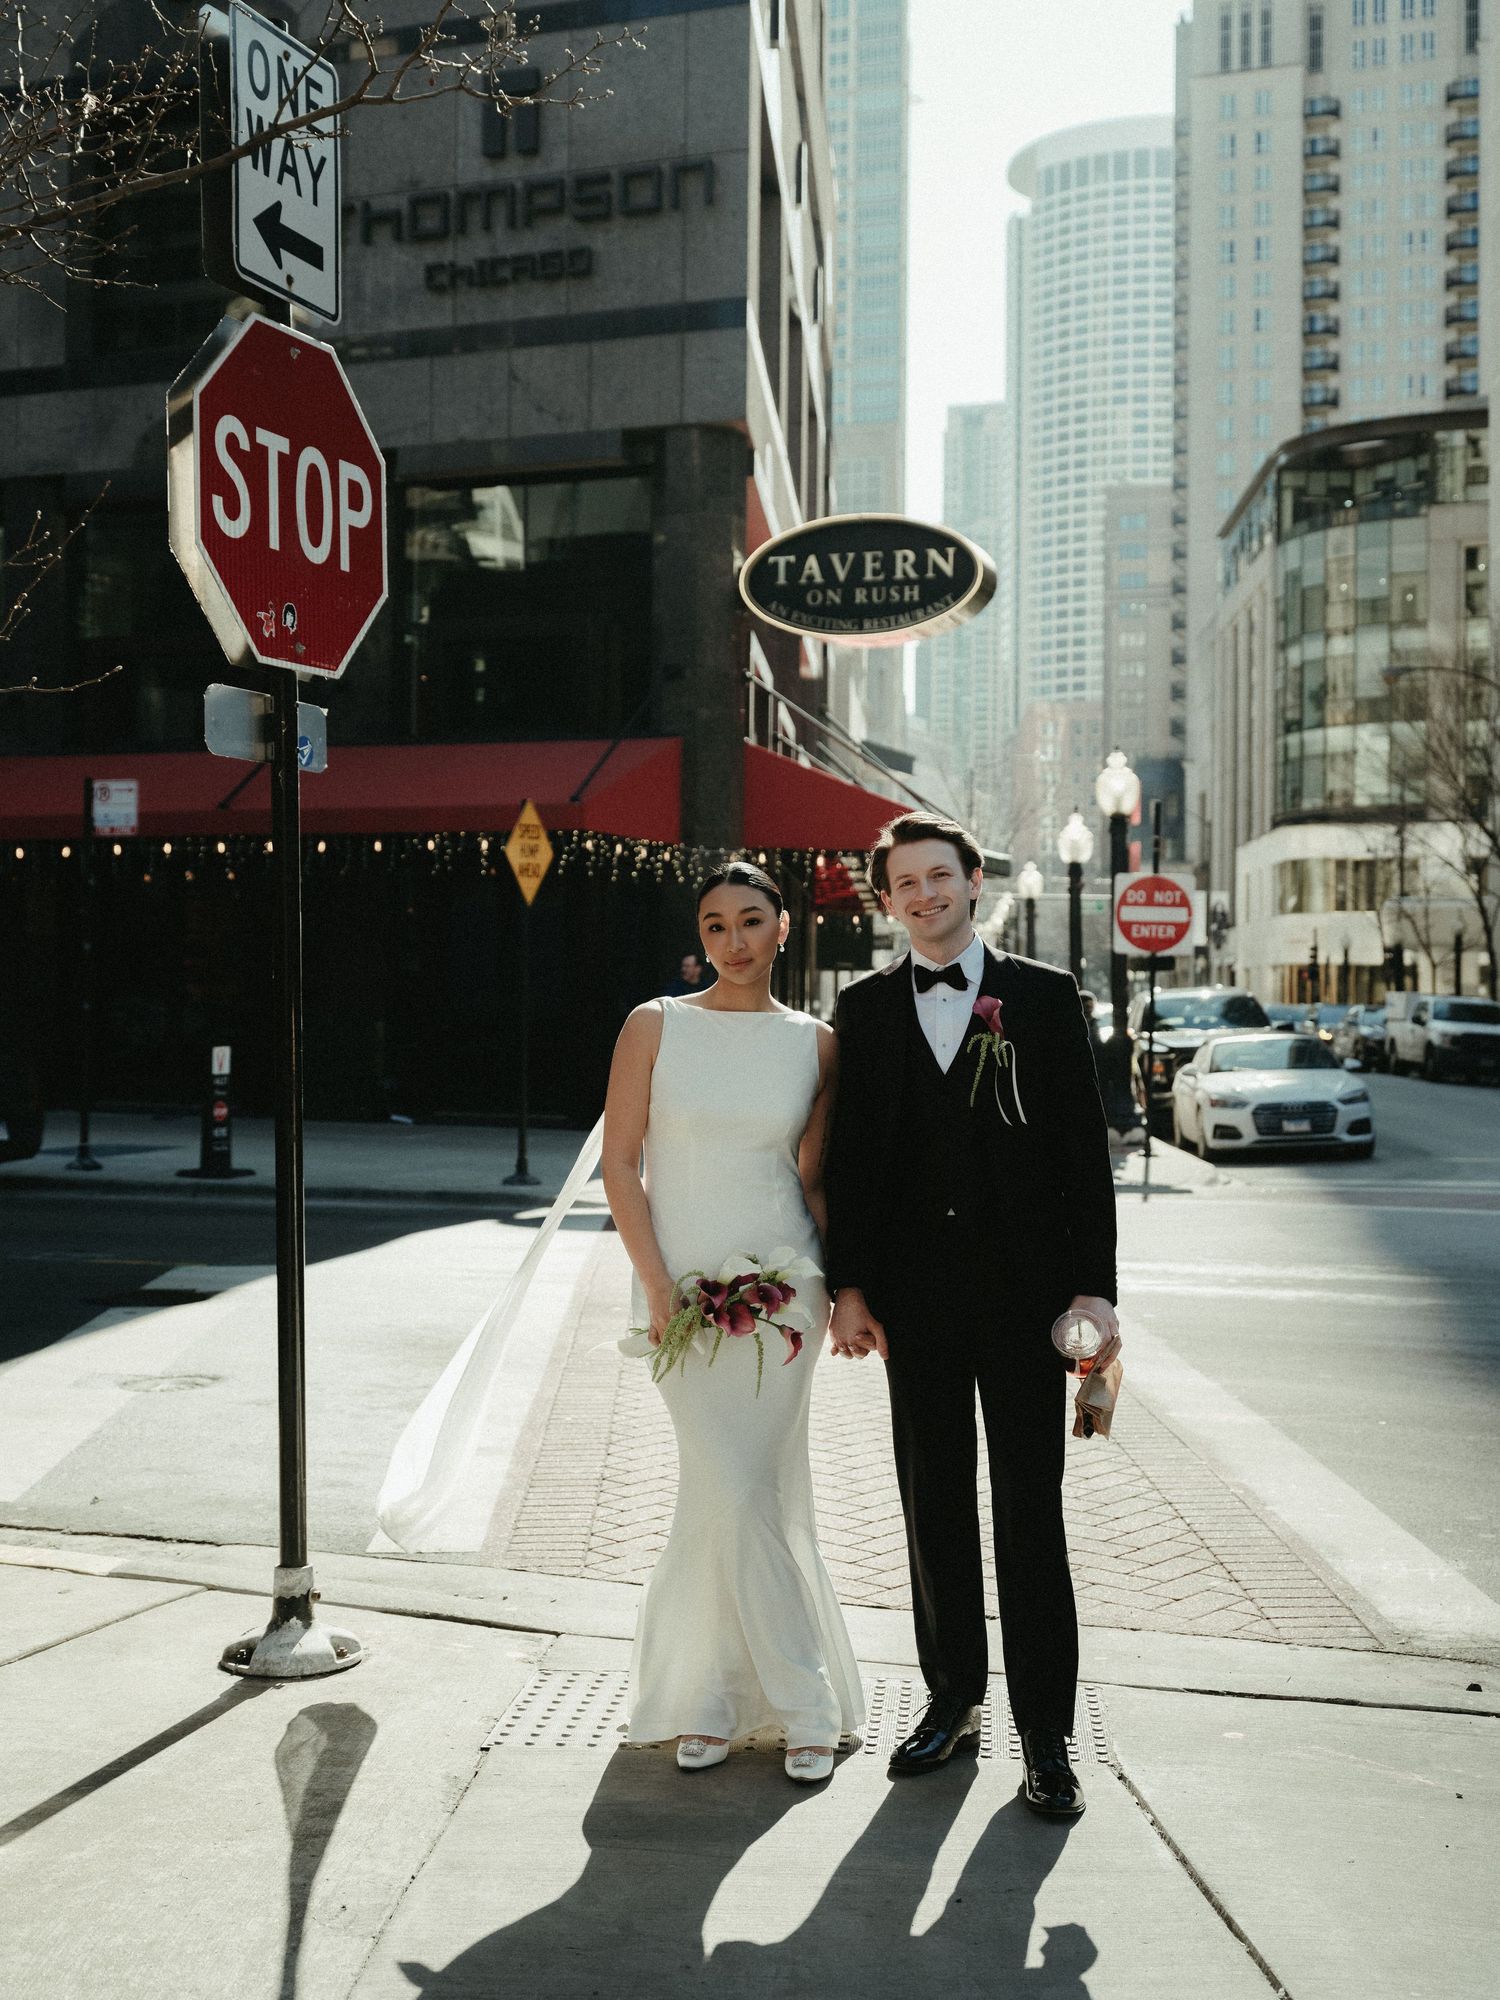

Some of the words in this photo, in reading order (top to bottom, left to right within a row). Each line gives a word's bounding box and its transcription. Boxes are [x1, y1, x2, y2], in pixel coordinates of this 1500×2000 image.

[248, 39, 324, 135] ONE
[246, 107, 327, 207] WAY
[341, 158, 715, 246] hompson
[212, 414, 373, 573] STOP
[767, 546, 958, 586] TAVERN
[768, 600, 788, 617] AN
[793, 612, 858, 629] EXCITING
[863, 594, 953, 629] RESTAURANT
[806, 588, 843, 607] ON
[854, 585, 921, 605] RUSH
[1126, 889, 1147, 905] DO
[1153, 890, 1183, 905] NOT
[1131, 924, 1176, 939] ENTER
